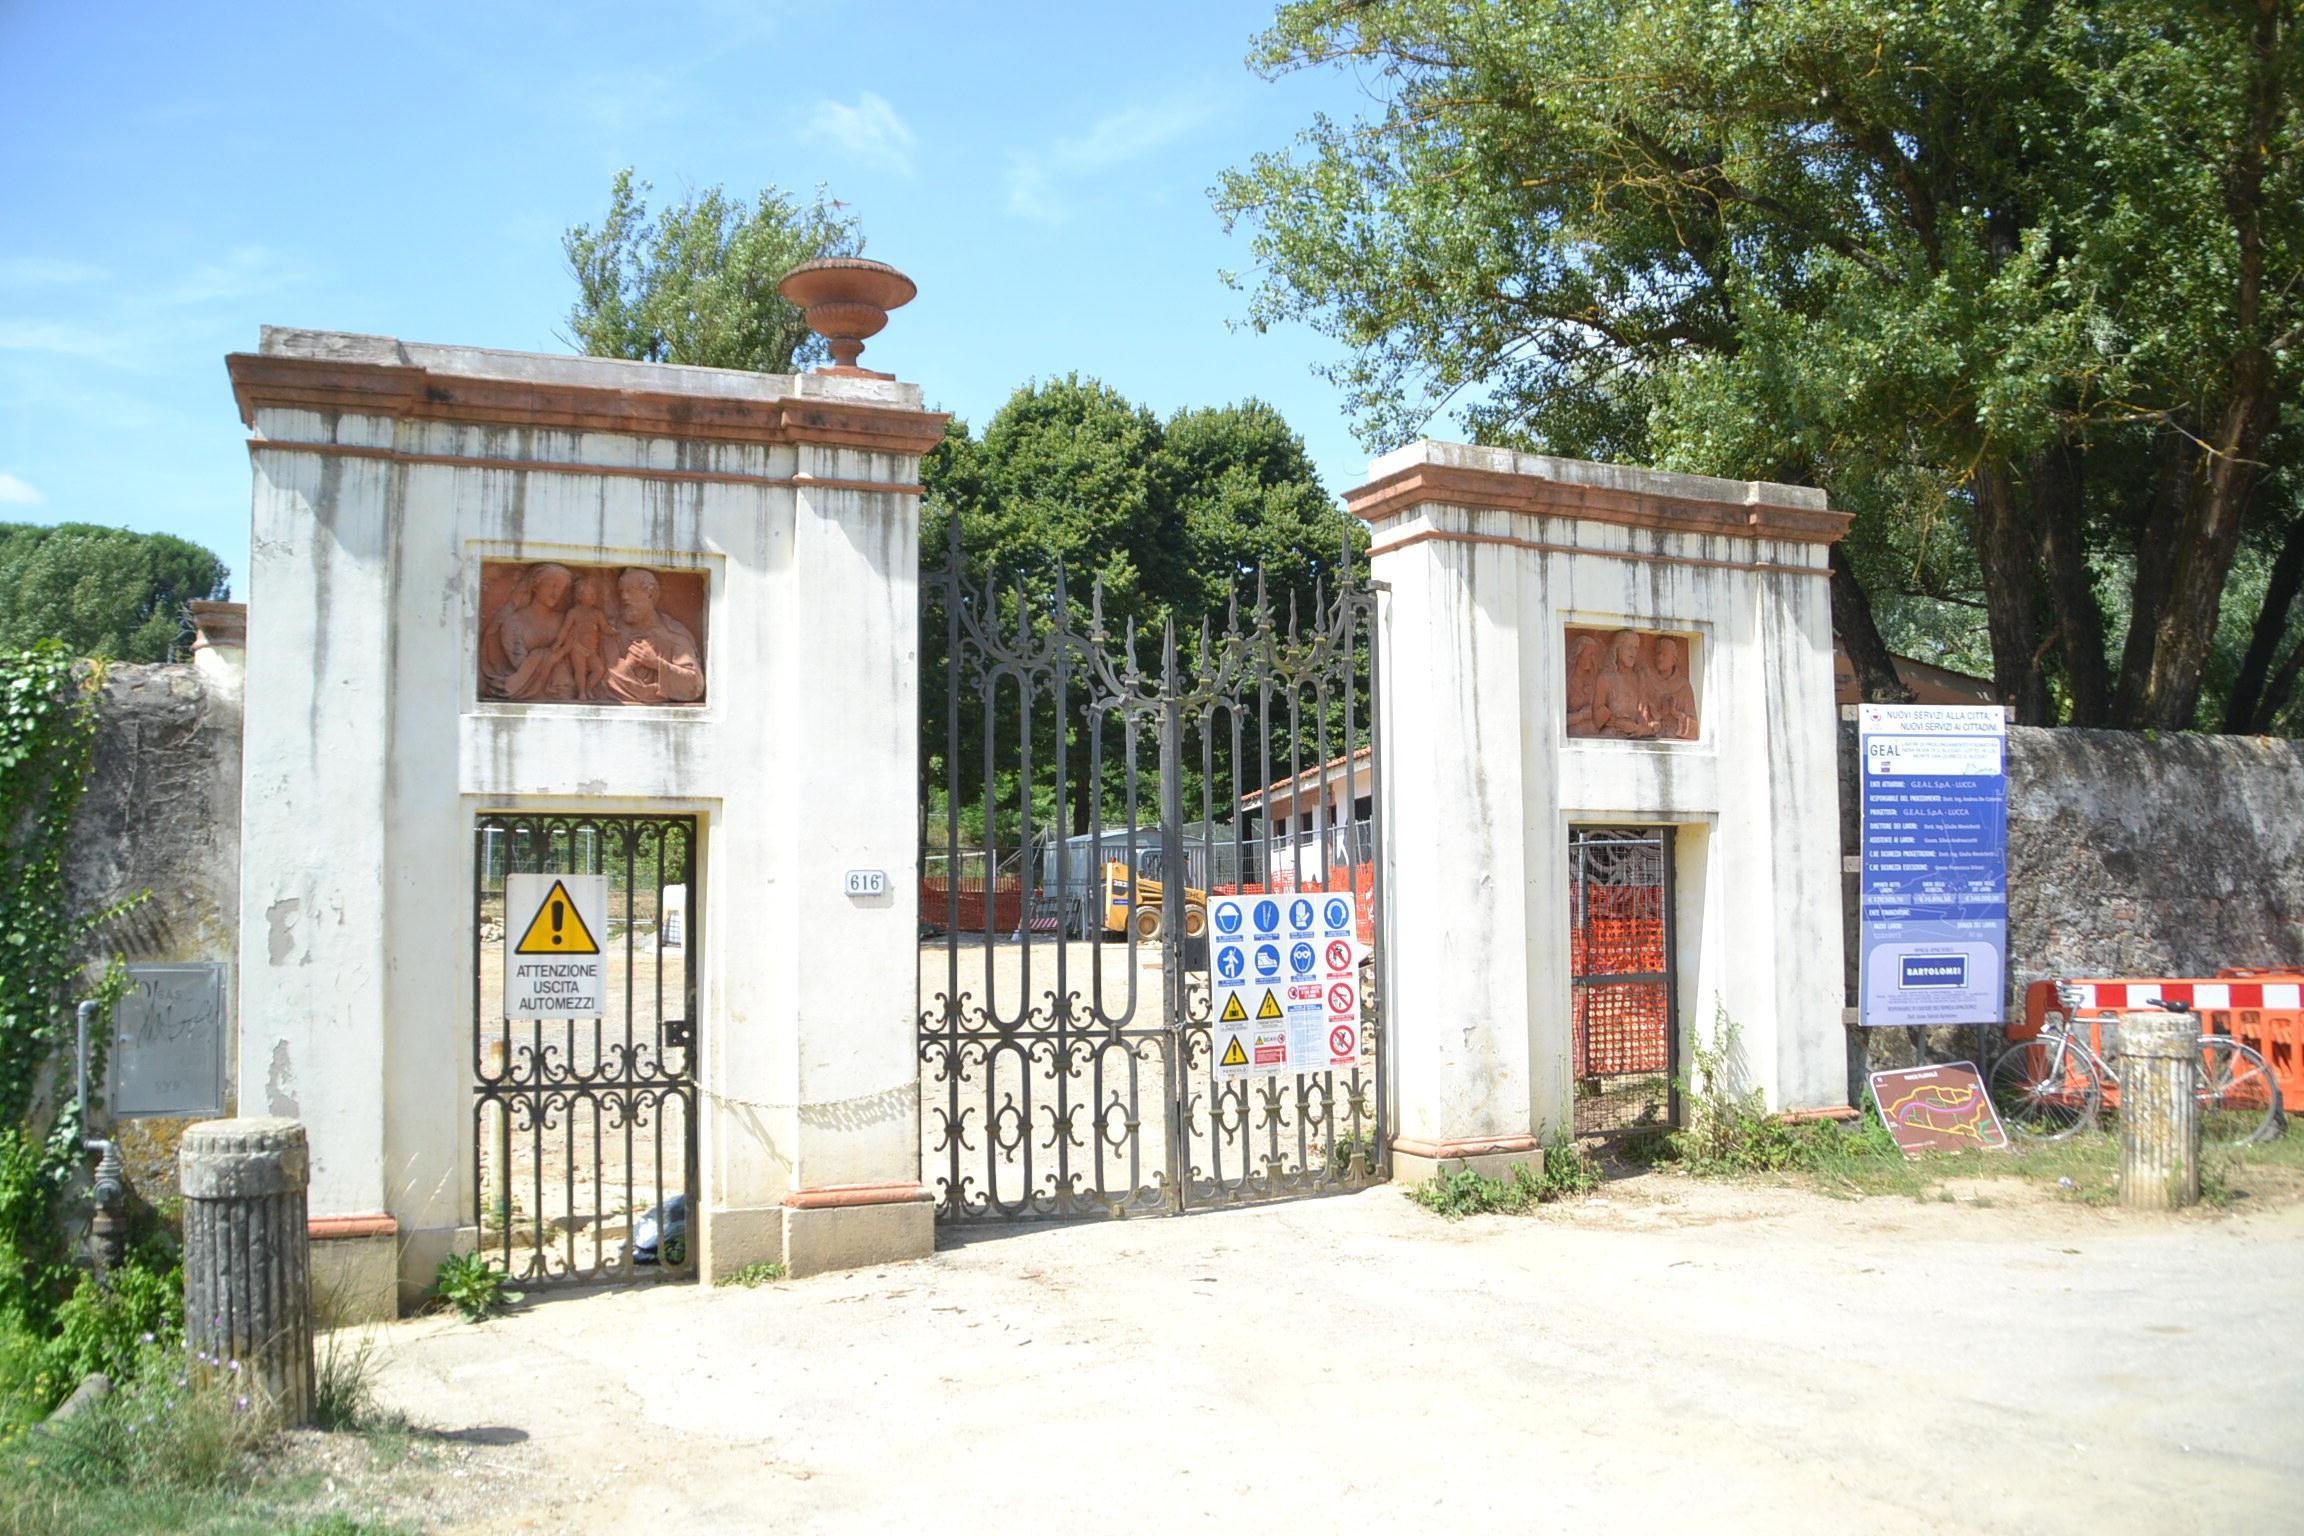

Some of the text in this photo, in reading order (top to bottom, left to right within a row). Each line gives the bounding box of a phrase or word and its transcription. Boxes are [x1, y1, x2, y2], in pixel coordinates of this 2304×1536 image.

[1887, 711, 1911, 719] NUOVI
[1913, 711, 1943, 719] SERVIZI
[1946, 711, 1966, 720] ALLA
[1901, 722, 1922, 731] NUOVI
[1925, 722, 1952, 731] SERVIZI
[1870, 744, 1901, 757] GEAL
[850, 874, 881, 891] 616
[516, 964, 598, 978] ATTENZIONE
[533, 981, 580, 994] USCITA
[519, 997, 595, 1011] AUTOMEZZI
